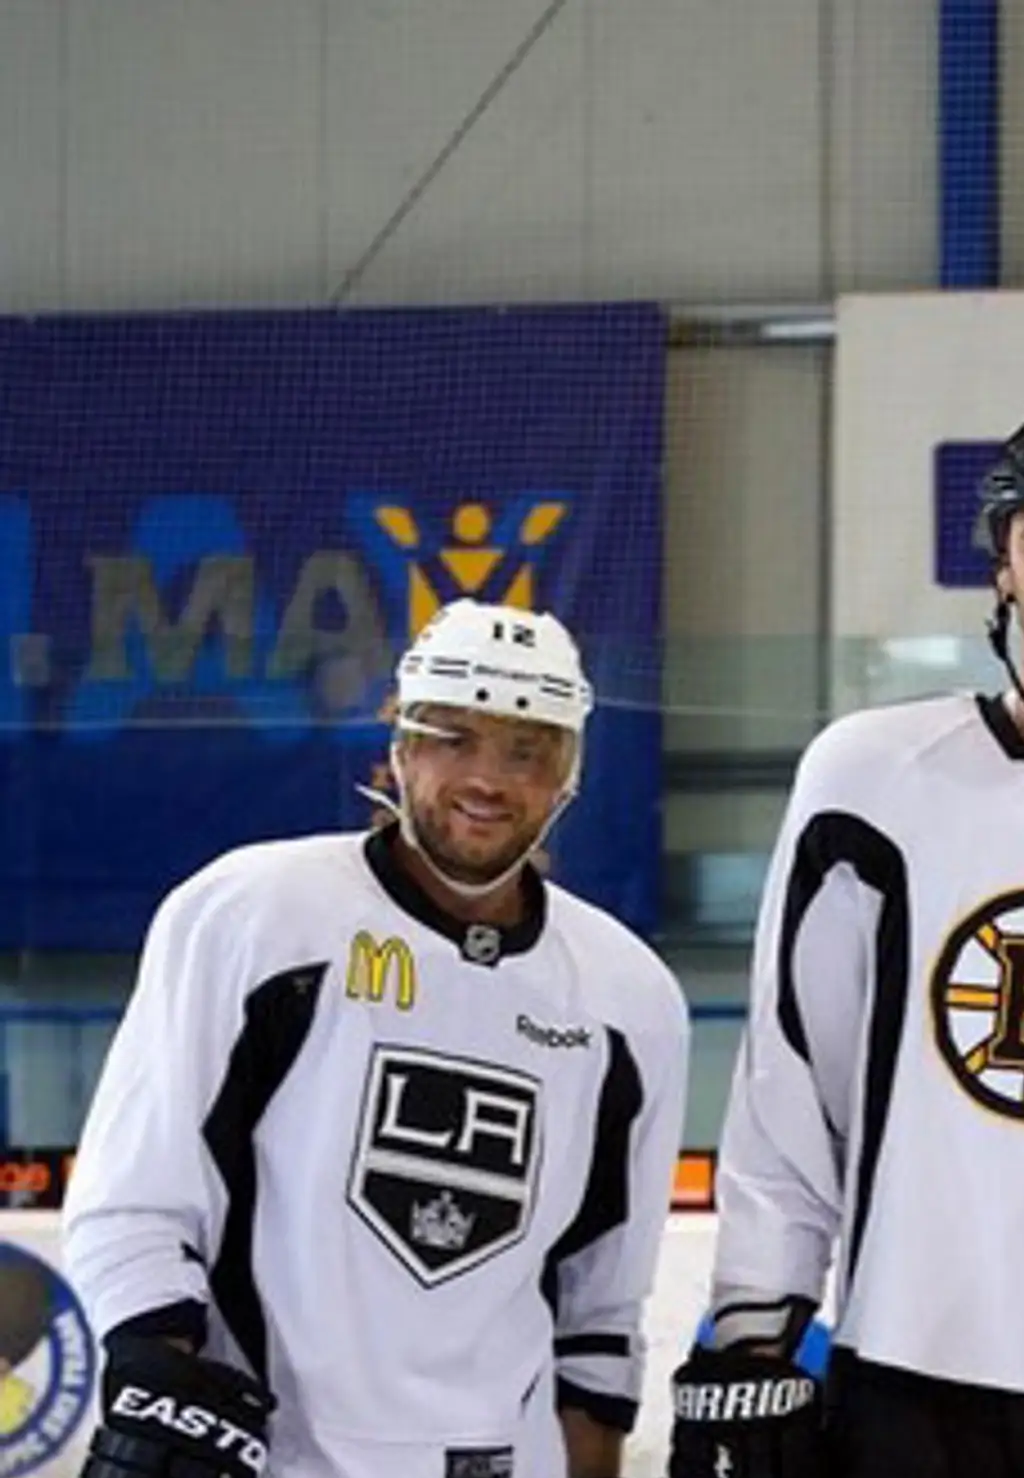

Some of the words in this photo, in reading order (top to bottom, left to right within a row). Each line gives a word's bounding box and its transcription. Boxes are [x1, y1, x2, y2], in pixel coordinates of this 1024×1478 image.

[493, 621, 536, 648] 12
[378, 1072, 531, 1165] LA
[112, 1385, 267, 1473] EASTO
